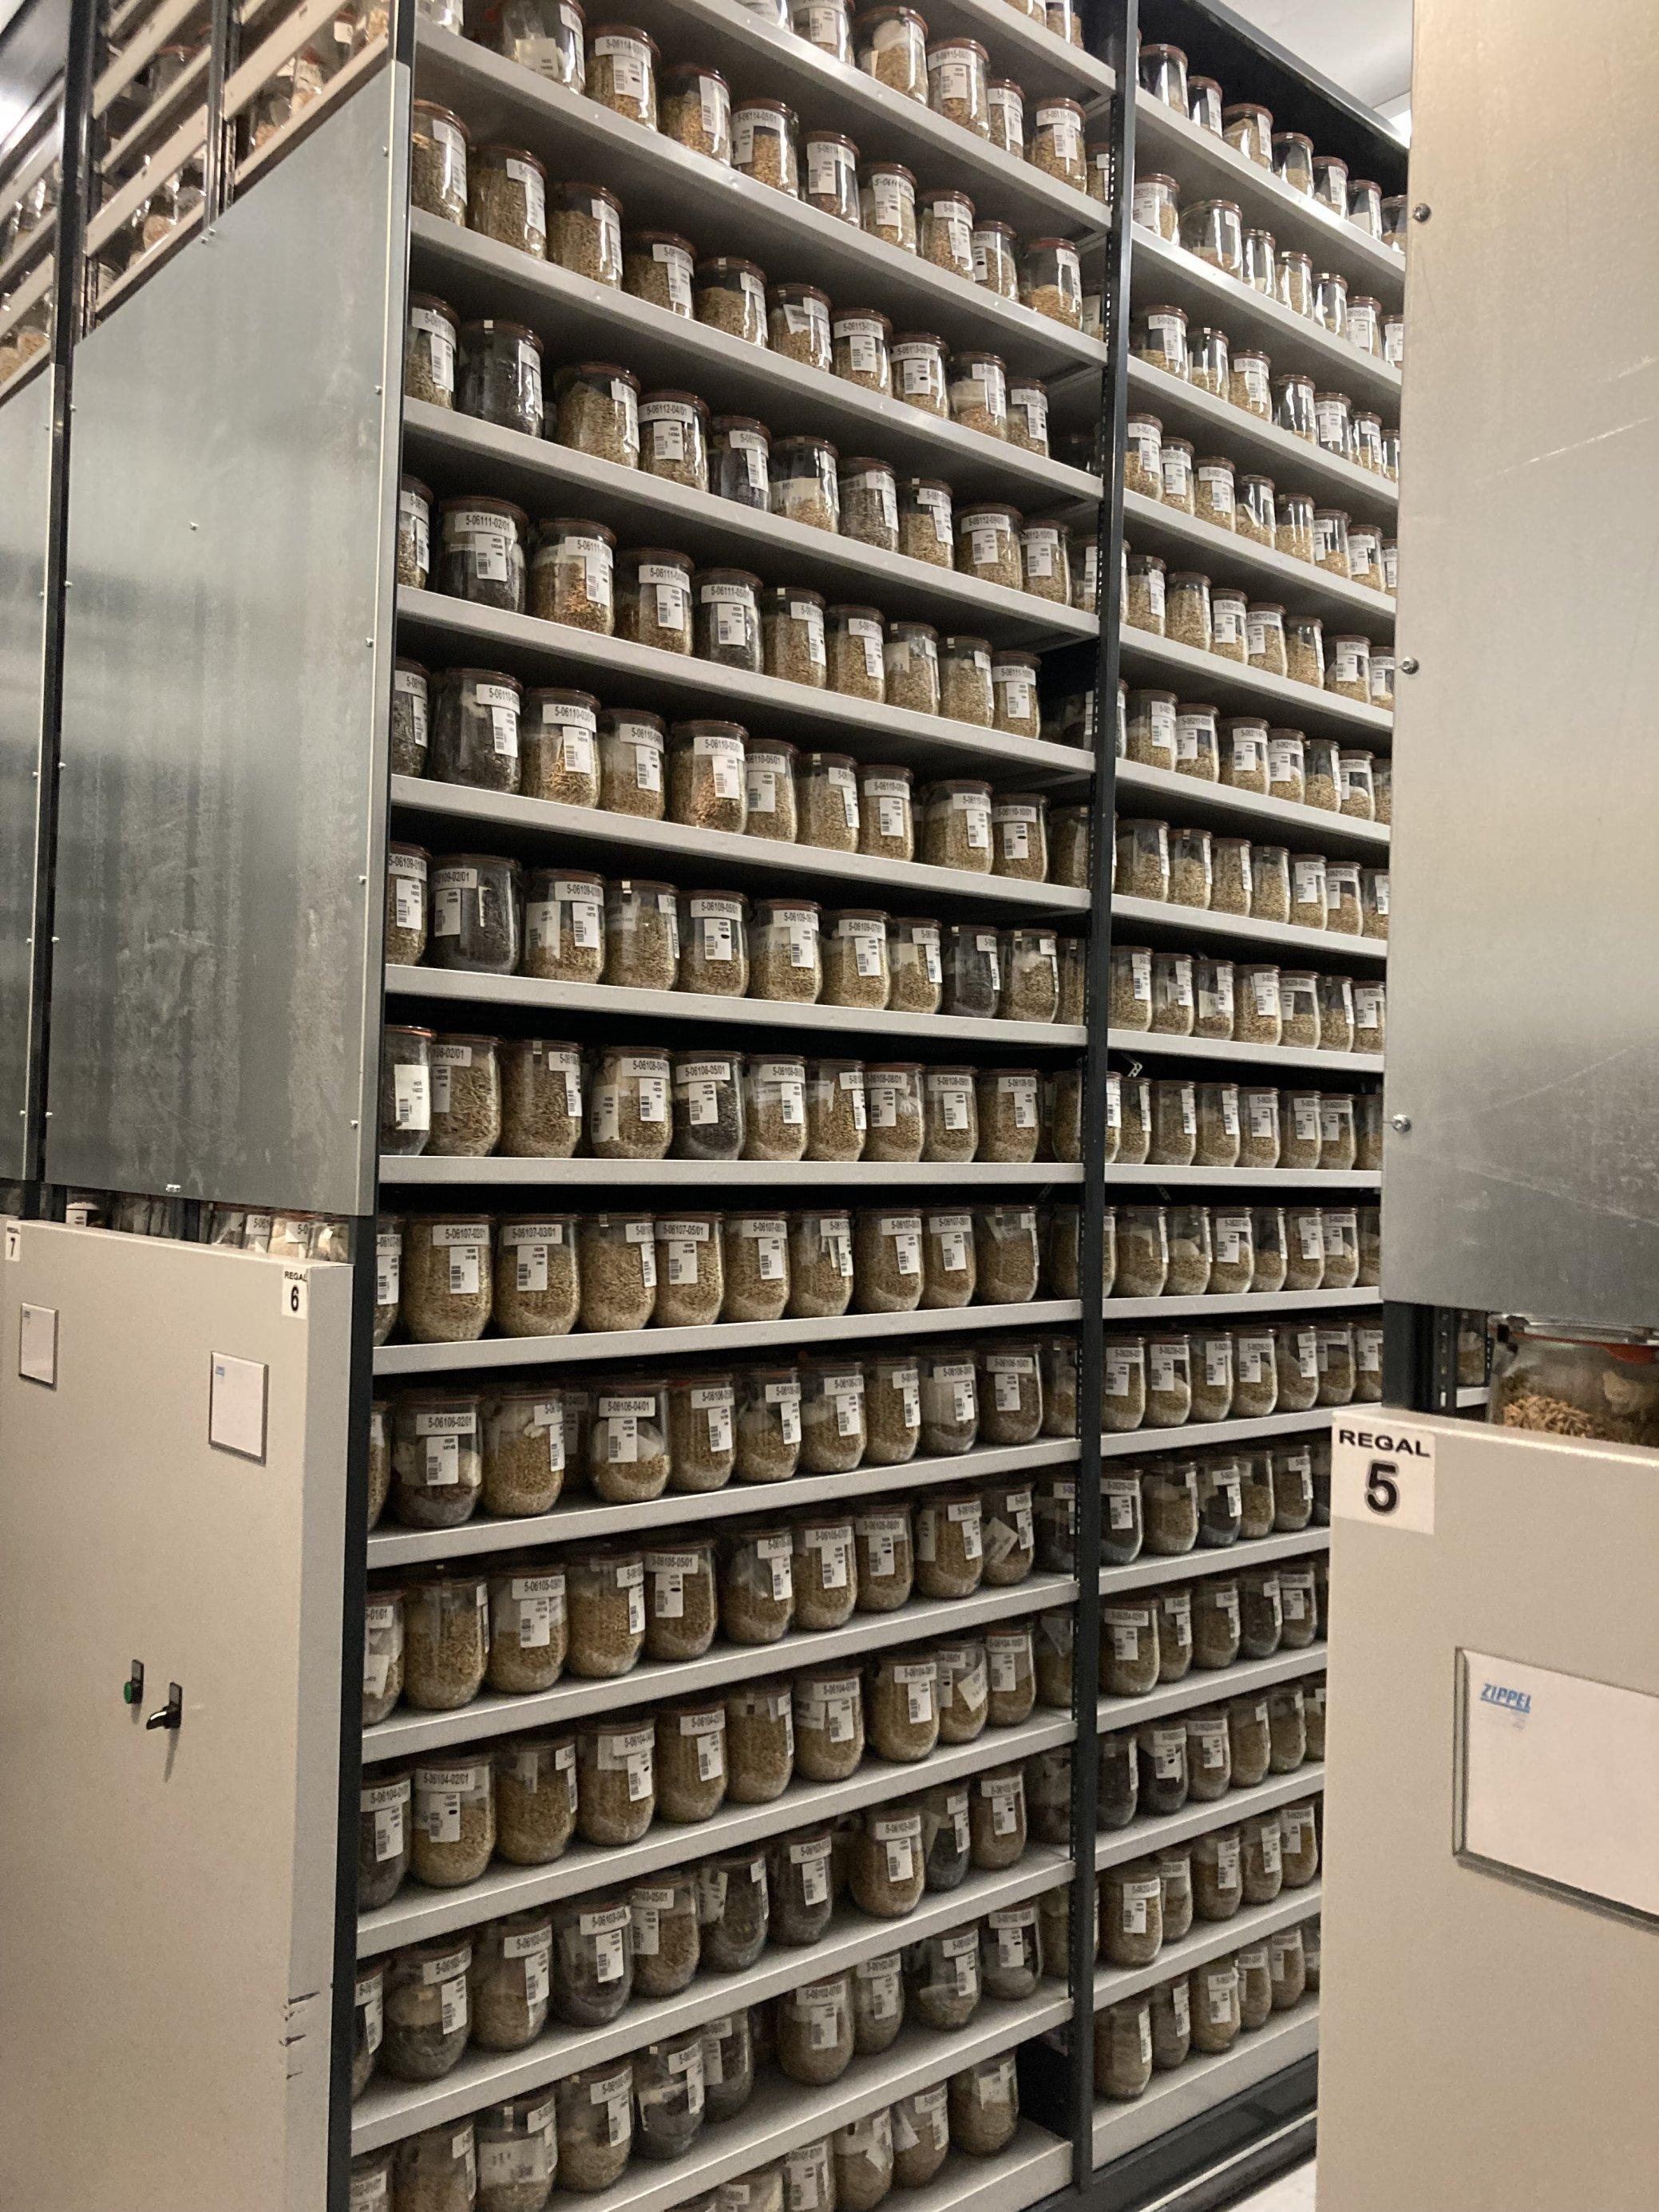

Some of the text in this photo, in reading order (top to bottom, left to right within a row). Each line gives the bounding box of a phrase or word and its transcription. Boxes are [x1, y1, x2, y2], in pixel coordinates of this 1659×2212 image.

[465, 515, 510, 532] 5-06111-02/01
[10, 1237, 16, 1257] 7
[284, 1271, 308, 1282] REGAL
[290, 1285, 299, 1312] 6
[1339, 1430, 1430, 1458] REGAL
[1365, 1460, 1400, 1514] 5
[1481, 1683, 1532, 1711] ZIPPEL
